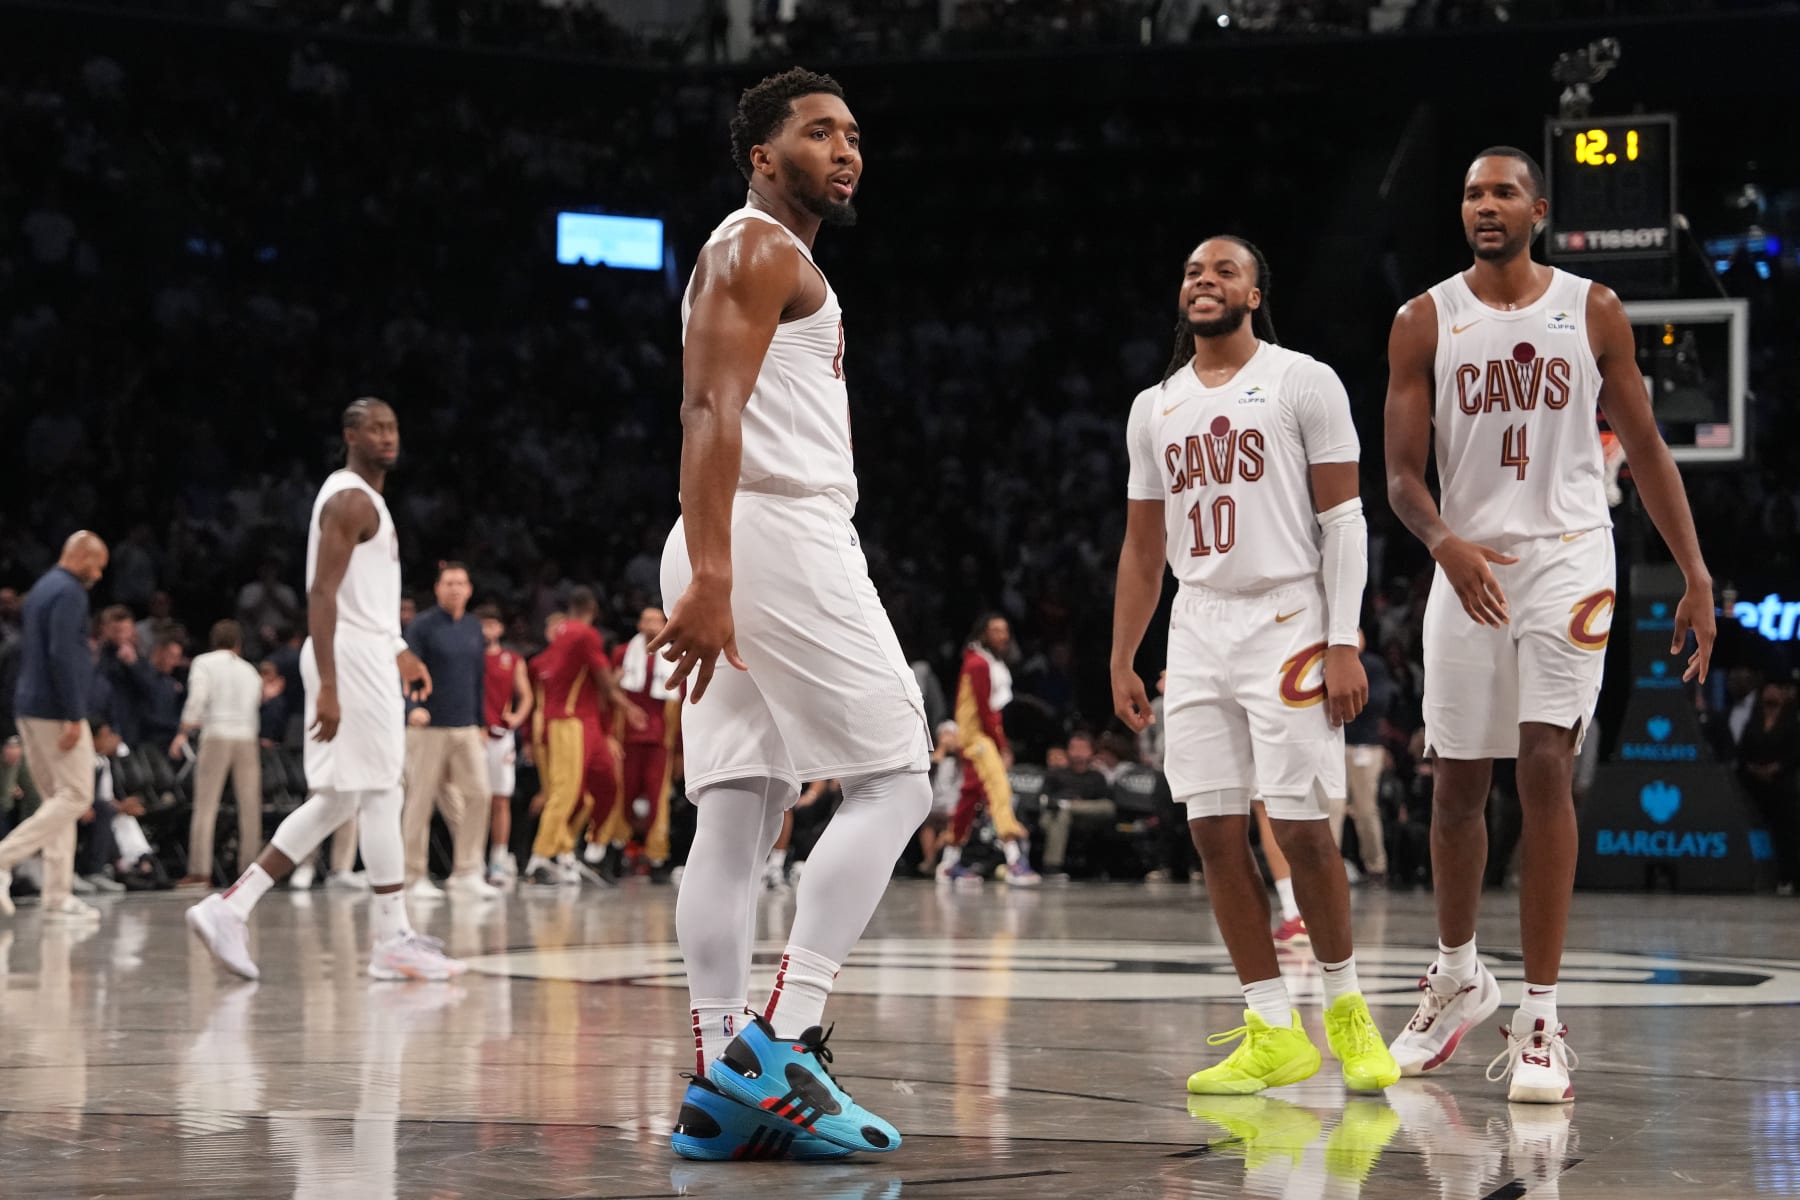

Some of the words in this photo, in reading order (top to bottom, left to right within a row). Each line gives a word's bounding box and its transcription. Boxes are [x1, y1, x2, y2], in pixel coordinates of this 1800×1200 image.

[1575, 129, 1639, 166] 12.1
[1586, 227, 1668, 250] TISSOT
[1456, 357, 1570, 416] CAVS
[1165, 428, 1265, 494] CAVS
[1501, 421, 1530, 481] 4
[1188, 495, 1236, 557] 10
[1596, 829, 1729, 858] BARCLAYS
